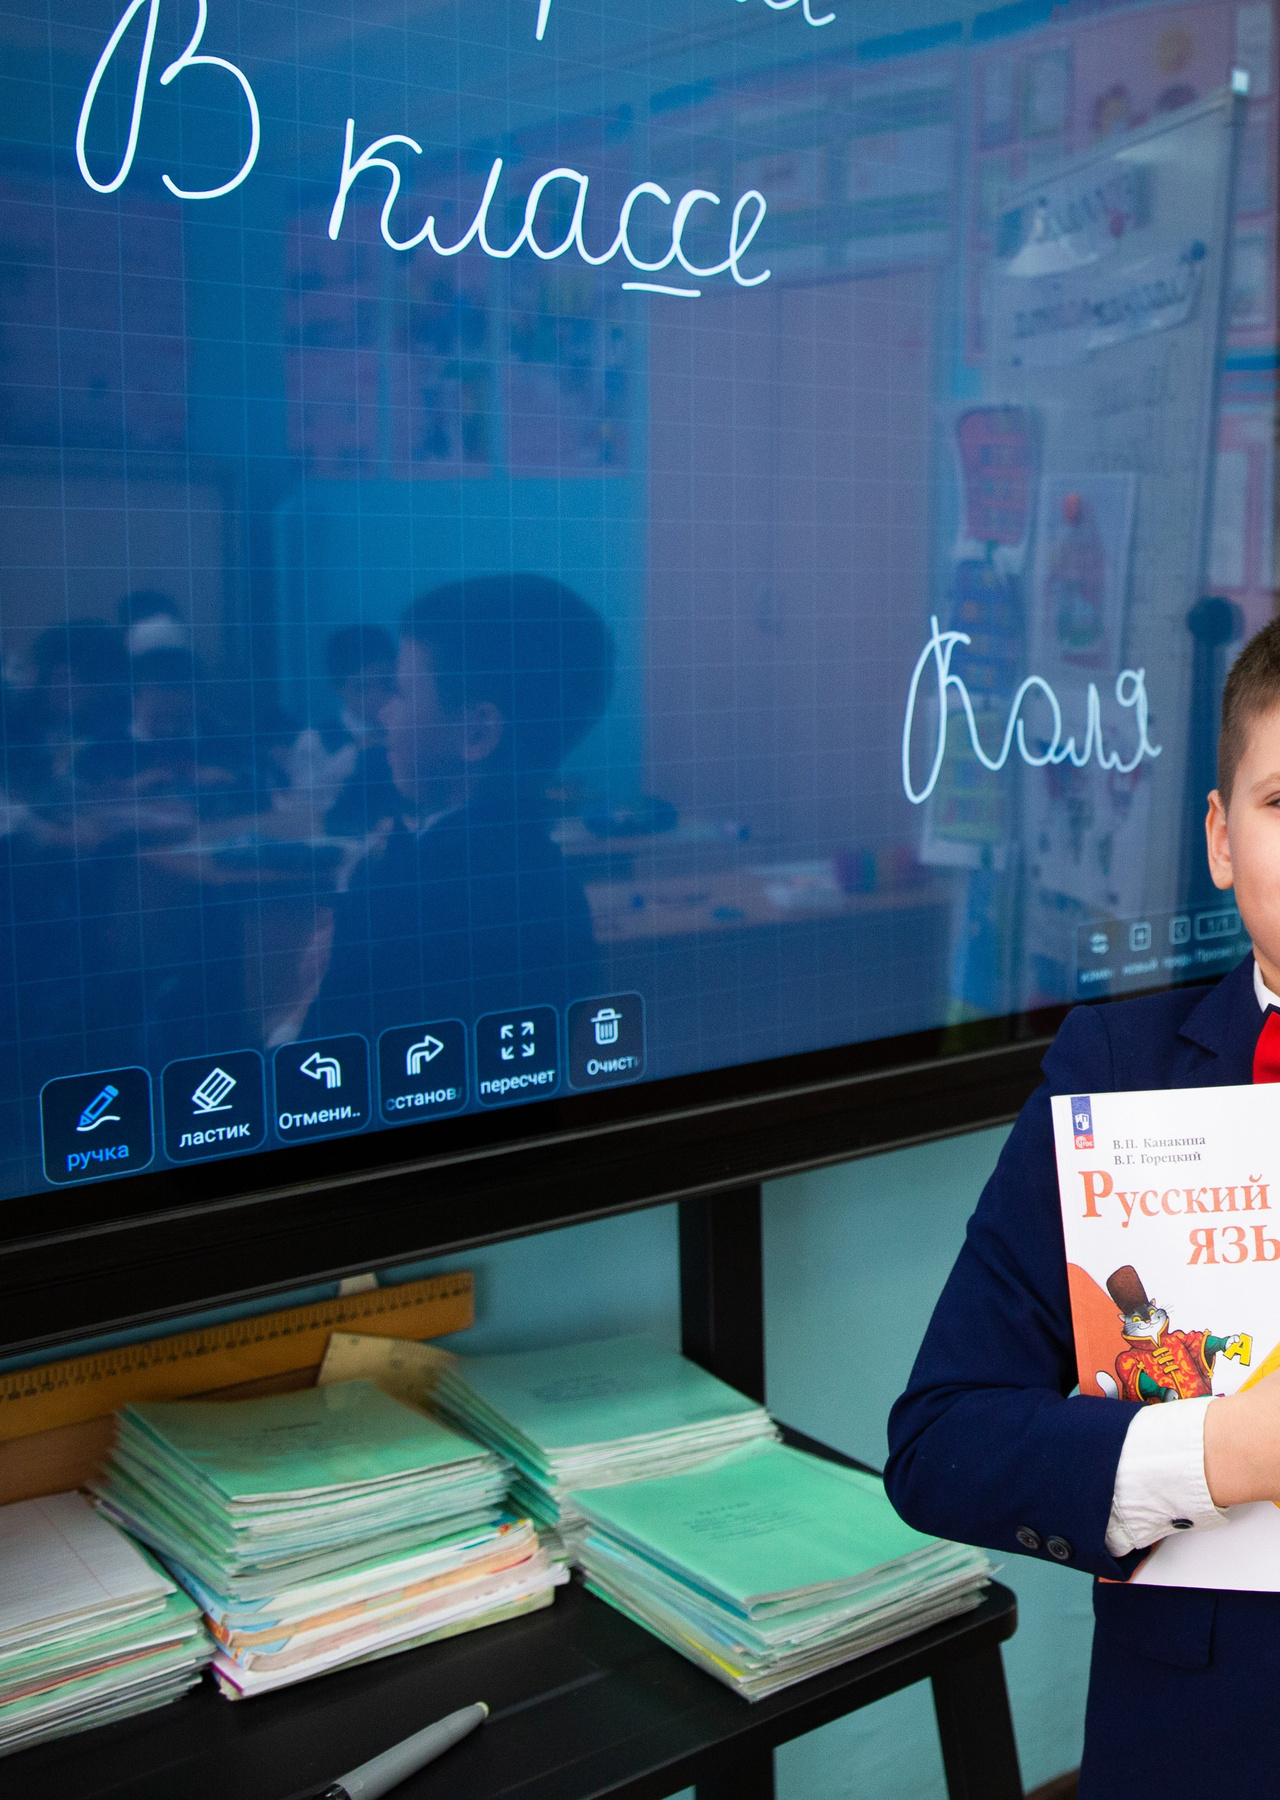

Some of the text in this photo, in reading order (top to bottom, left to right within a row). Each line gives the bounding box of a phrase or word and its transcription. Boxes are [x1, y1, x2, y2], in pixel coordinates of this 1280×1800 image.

[75, 0, 773, 290] В классе
[902, 614, 1163, 805] Коля
[480, 1069, 556, 1095] пересчет
[178, 1120, 252, 1149] ластик
[1143, 1136, 1206, 1149] Канакина
[66, 1140, 131, 1172] ручка
[1141, 1151, 1202, 1166] Горецкий
[1077, 1170, 1273, 1228] Русский
